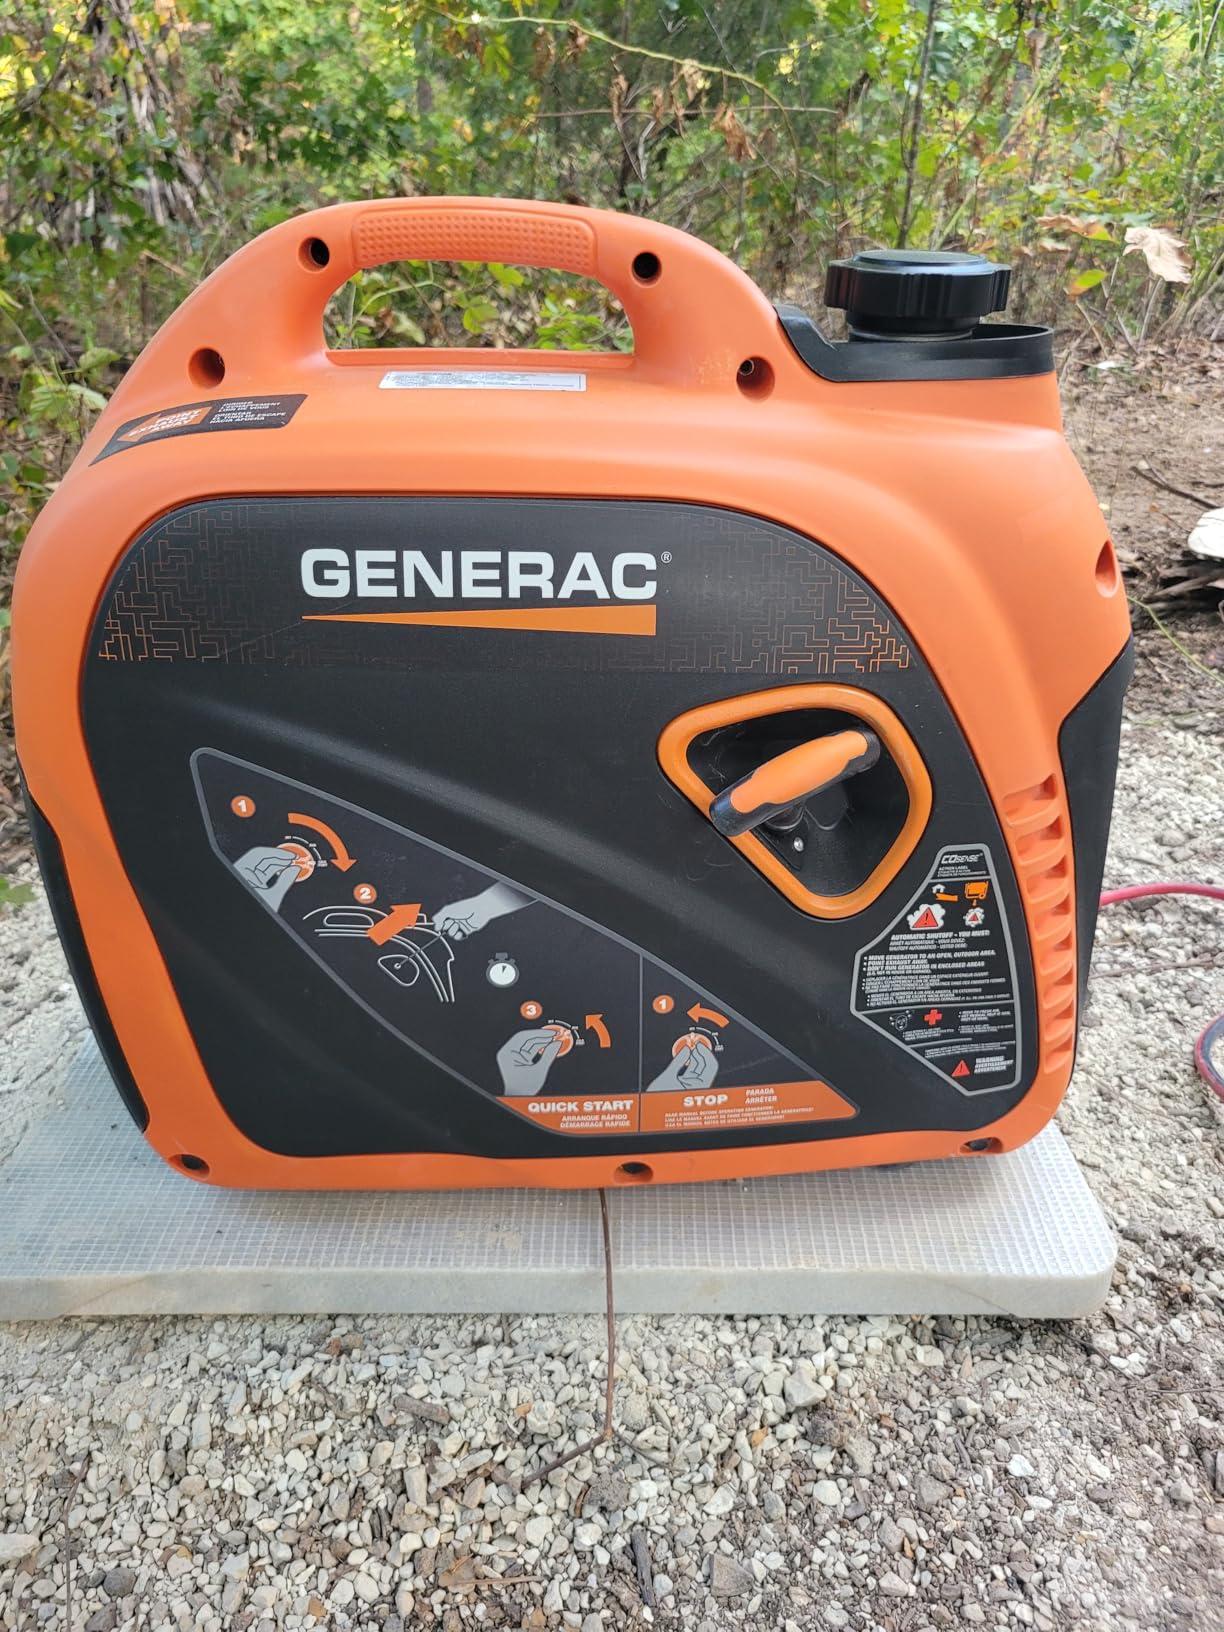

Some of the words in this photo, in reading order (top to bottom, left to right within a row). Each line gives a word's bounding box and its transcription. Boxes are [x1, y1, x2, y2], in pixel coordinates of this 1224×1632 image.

[156, 409, 202, 423] POINT
[128, 415, 197, 436] EXHAUST
[150, 420, 193, 432] AWAY
[238, 800, 248, 813] 1
[360, 887, 372, 899] 2
[891, 933, 926, 941] AUTOMATIC
[927, 931, 954, 939] SHUTOFF
[658, 999, 667, 1010] 1
[526, 1005, 537, 1016] 3
[745, 1087, 775, 1096] PARADA
[683, 1093, 729, 1108] STOP
[744, 1094, 778, 1105] ARRÊTER
[528, 1101, 579, 1113] QUICK
[583, 1099, 634, 1112] START
[561, 1114, 600, 1122] ARRANQUE
[601, 1112, 628, 1121] RÁPIDO
[604, 1119, 631, 1128] RAPIDE
